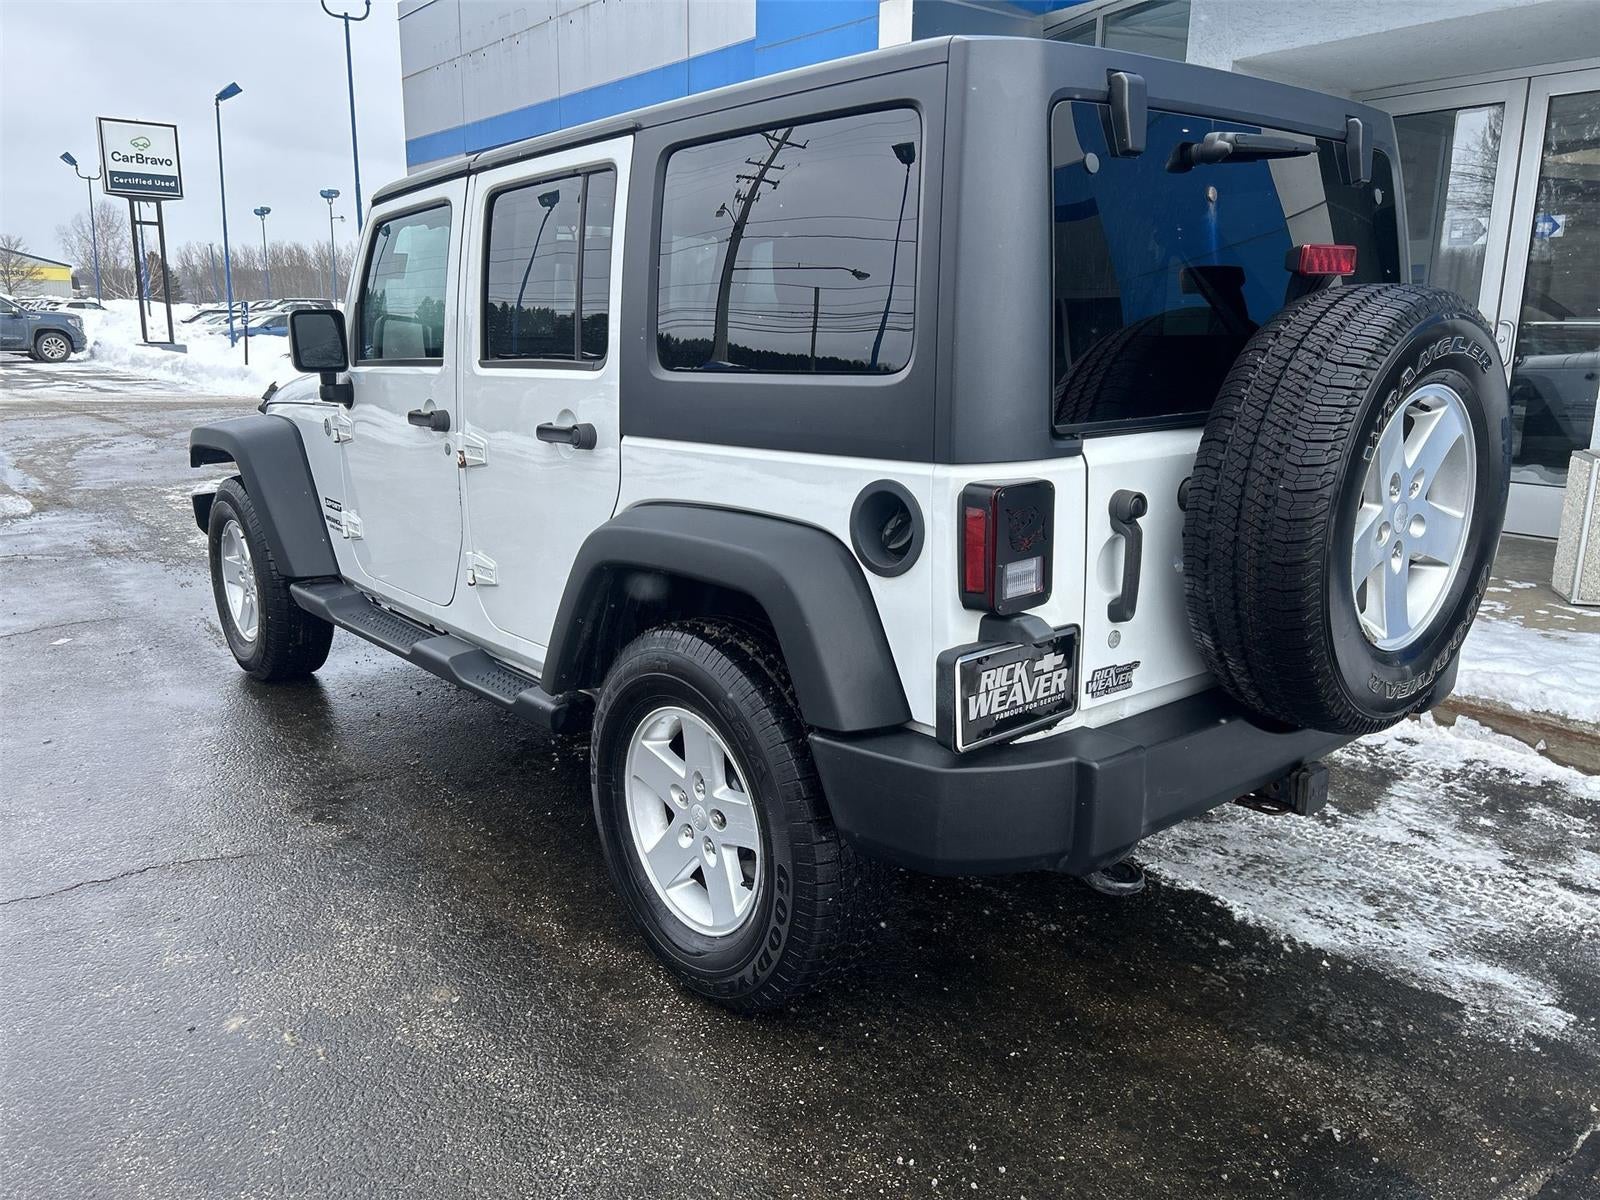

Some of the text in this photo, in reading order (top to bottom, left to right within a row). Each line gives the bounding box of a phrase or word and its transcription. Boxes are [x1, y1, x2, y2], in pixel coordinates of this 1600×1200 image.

[111, 151, 173, 167] CarBravo
[113, 177, 176, 188] Certified Used
[1363, 336, 1493, 461] WRANGLER
[1367, 565, 1490, 700] GOODYEAR
[979, 660, 1029, 693] RICK
[1088, 671, 1133, 693] WEAVER
[1093, 666, 1117, 682] RICK
[968, 668, 1068, 721] WEAVER
[995, 692, 1065, 721] FAMOUS FOR SERVICE
